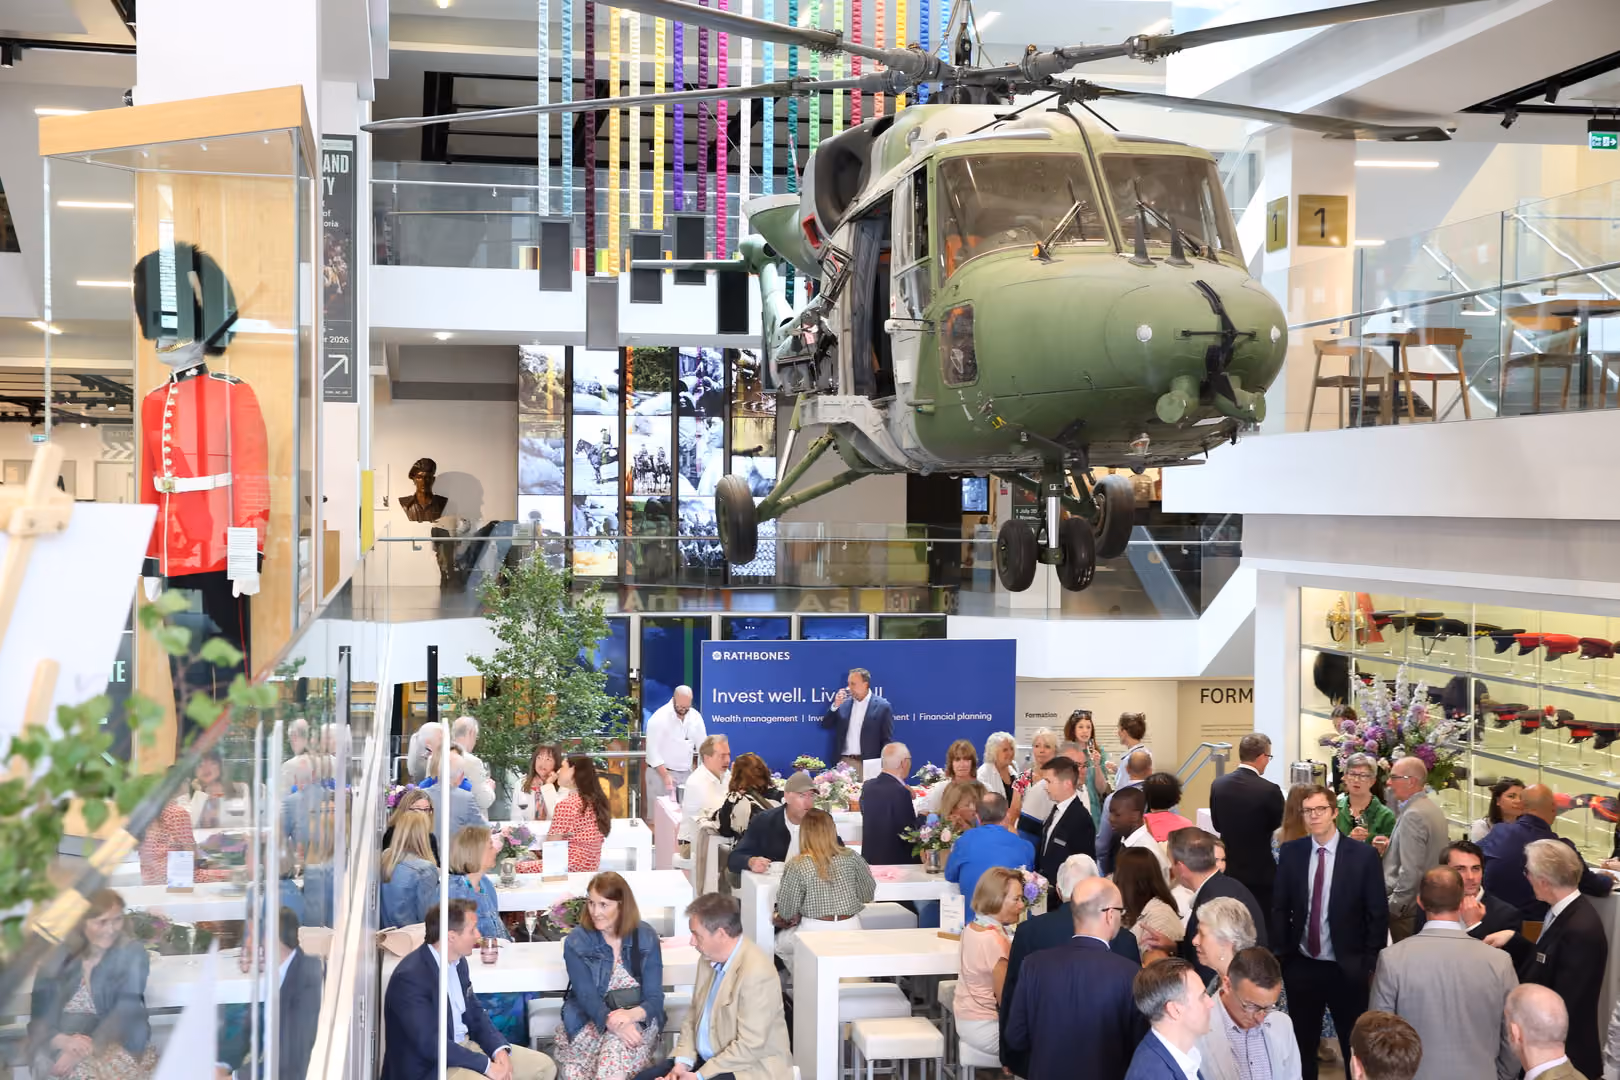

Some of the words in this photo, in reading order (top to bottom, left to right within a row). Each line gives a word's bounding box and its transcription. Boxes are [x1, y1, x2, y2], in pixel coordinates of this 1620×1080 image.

[323, 153, 349, 173] AND
[1272, 212, 1278, 242] 1
[1314, 207, 1325, 239] 1
[329, 335, 349, 344] 2026
[723, 651, 790, 661] RATHBONES
[712, 688, 764, 703] Invest
[768, 687, 807, 703] well.
[811, 687, 836, 703] Liv
[1200, 687, 1253, 704] FORM
[712, 714, 741, 723] Wealth
[743, 715, 798, 725] management
[919, 712, 956, 722] Financial
[957, 711, 993, 723] planning
[1025, 711, 1058, 719] Formation
